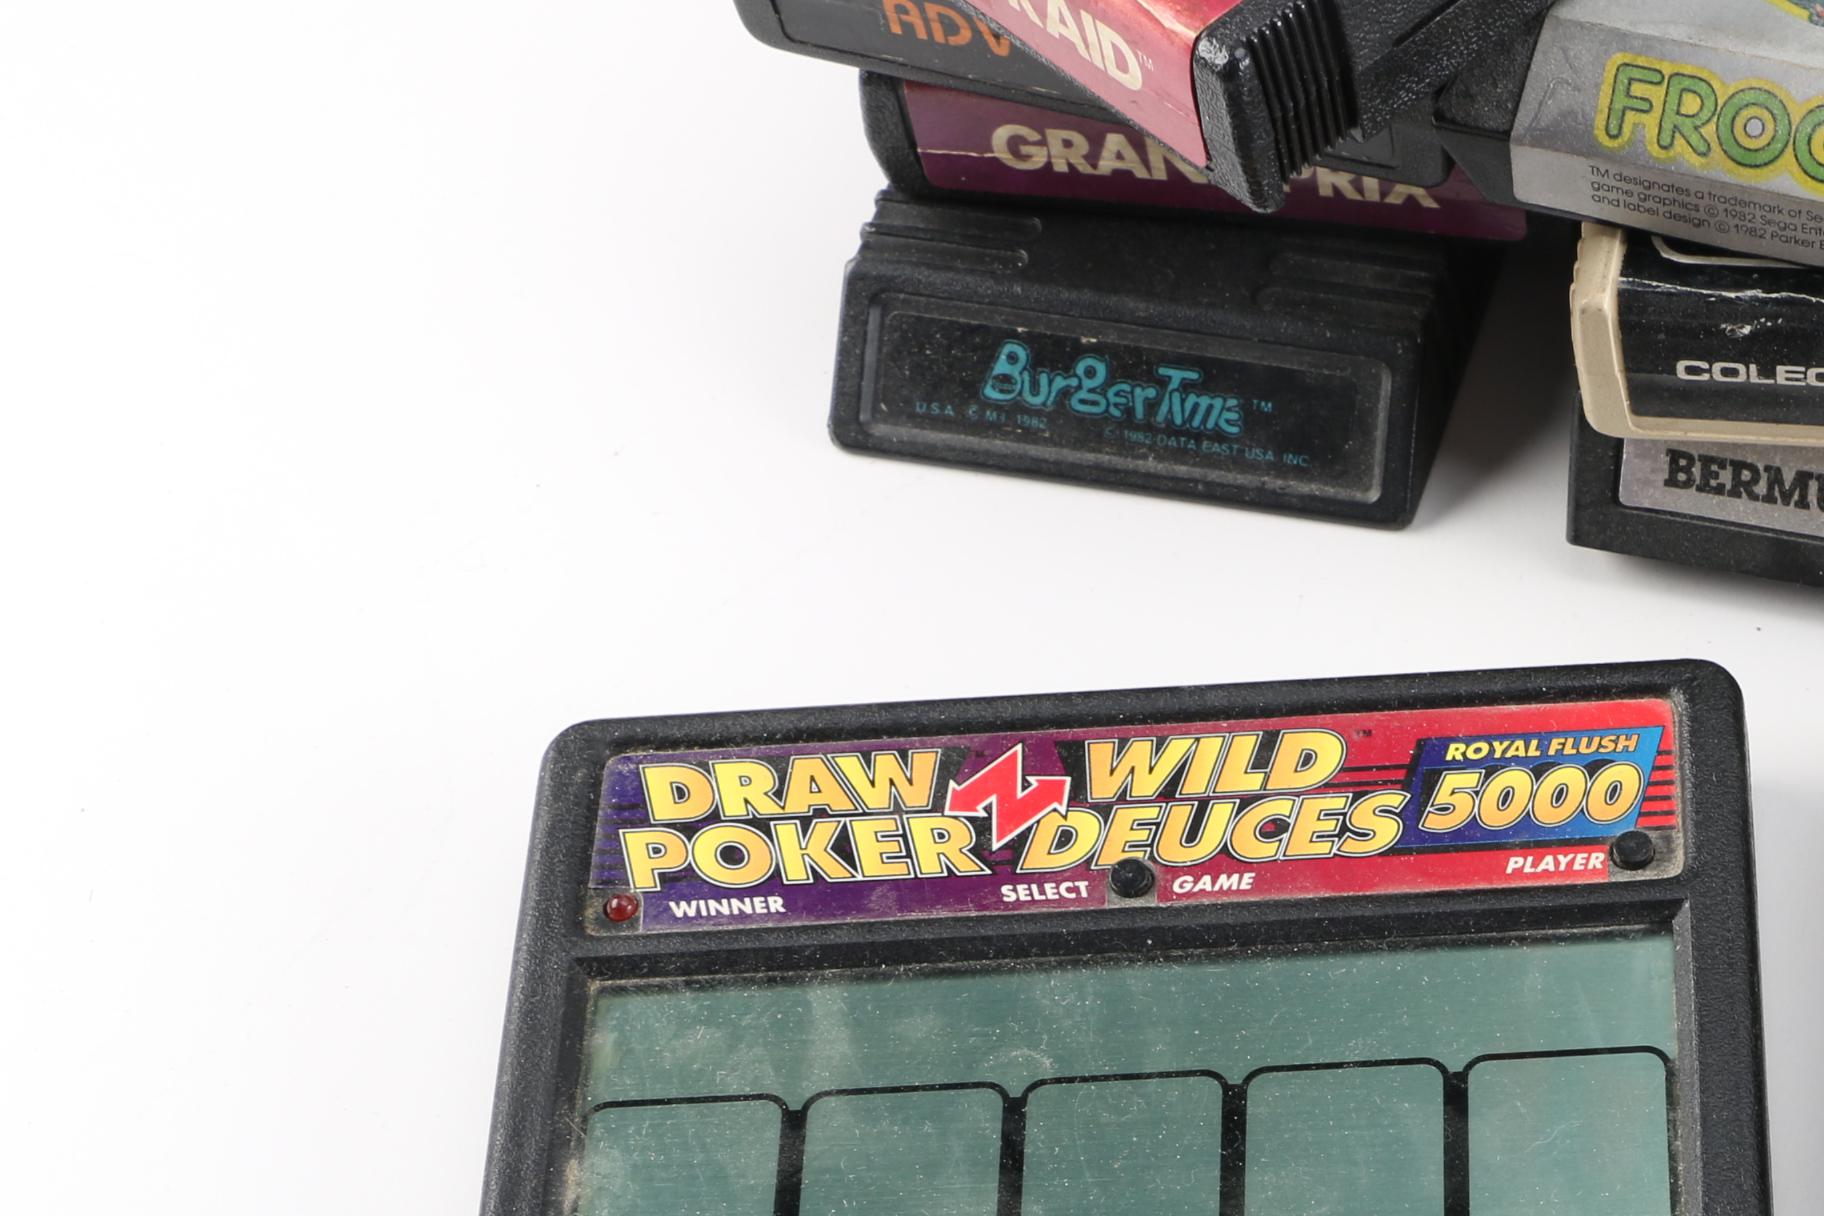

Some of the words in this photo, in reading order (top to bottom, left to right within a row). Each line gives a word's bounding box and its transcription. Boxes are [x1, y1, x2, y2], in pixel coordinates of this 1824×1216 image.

[1589, 165, 1609, 179] TM
[1613, 171, 1690, 198] designates
[1695, 191, 1705, 200] a
[1708, 192, 1784, 215] trademark
[1788, 207, 1802, 218] of
[1591, 180, 1634, 198] game
[1637, 190, 1700, 212] graphics
[1724, 209, 1755, 223] 1982
[1760, 214, 1798, 233] Sega
[1591, 193, 1620, 208] and
[1624, 199, 1659, 216] label
[1662, 210, 1710, 229] design
[1734, 225, 1765, 239] 1982
[1770, 230, 1815, 249] Parker
[1157, 436, 1197, 450] DATA
[1202, 442, 1239, 456] EAST
[1444, 737, 1545, 761] ROYAL
[1547, 733, 1639, 757] FLUSH
[640, 749, 941, 823] DRAW
[1086, 728, 1348, 800] WILD
[1420, 760, 1645, 833] 5000
[620, 812, 992, 891] POKER
[1016, 789, 1413, 873] DEUCES
[1506, 852, 1605, 875] PLAYER
[669, 895, 786, 918] WINNER
[1000, 880, 1089, 902] SELECT
[1172, 871, 1255, 894] GAME
